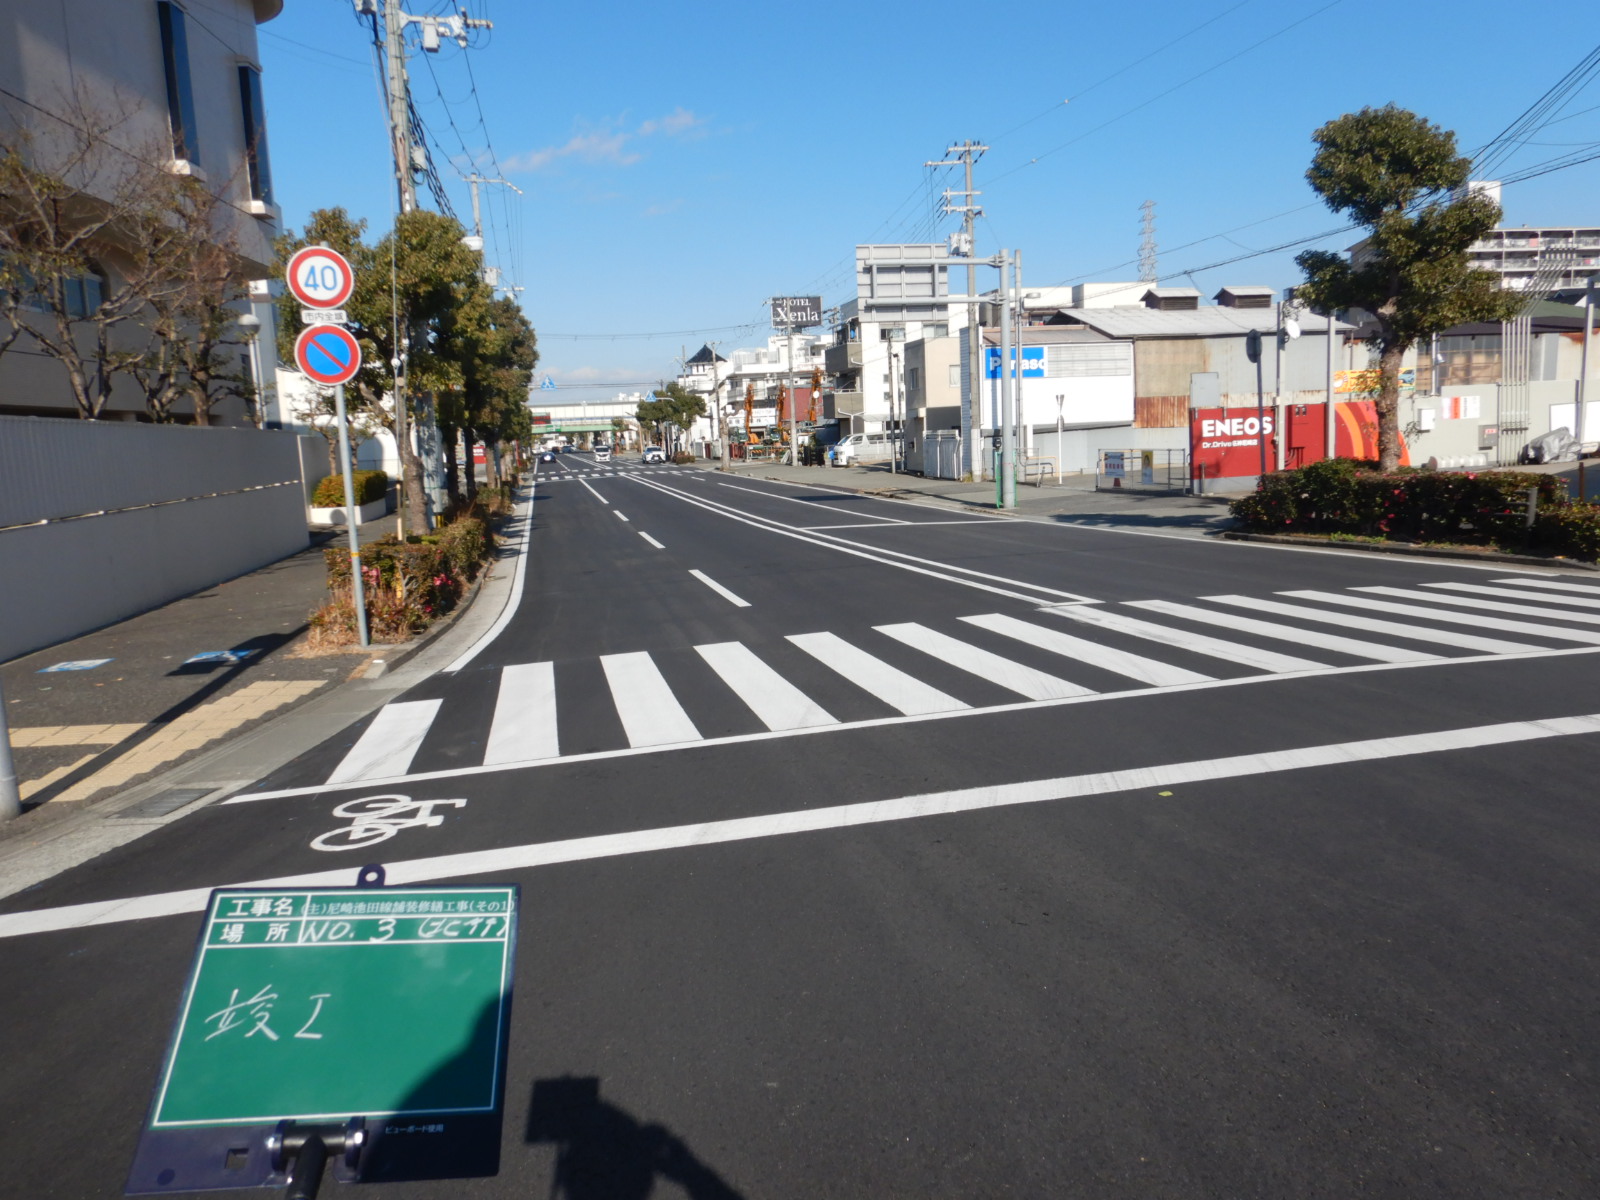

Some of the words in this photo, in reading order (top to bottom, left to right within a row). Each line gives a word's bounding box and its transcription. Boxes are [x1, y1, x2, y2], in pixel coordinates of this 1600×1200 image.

[304, 265, 337, 291] 40
[304, 312, 344, 321] 市内全域
[776, 307, 820, 322] Xenla
[1202, 416, 1273, 438] ENEOS
[226, 897, 294, 917] 工事名
[369, 918, 397, 943] 3
